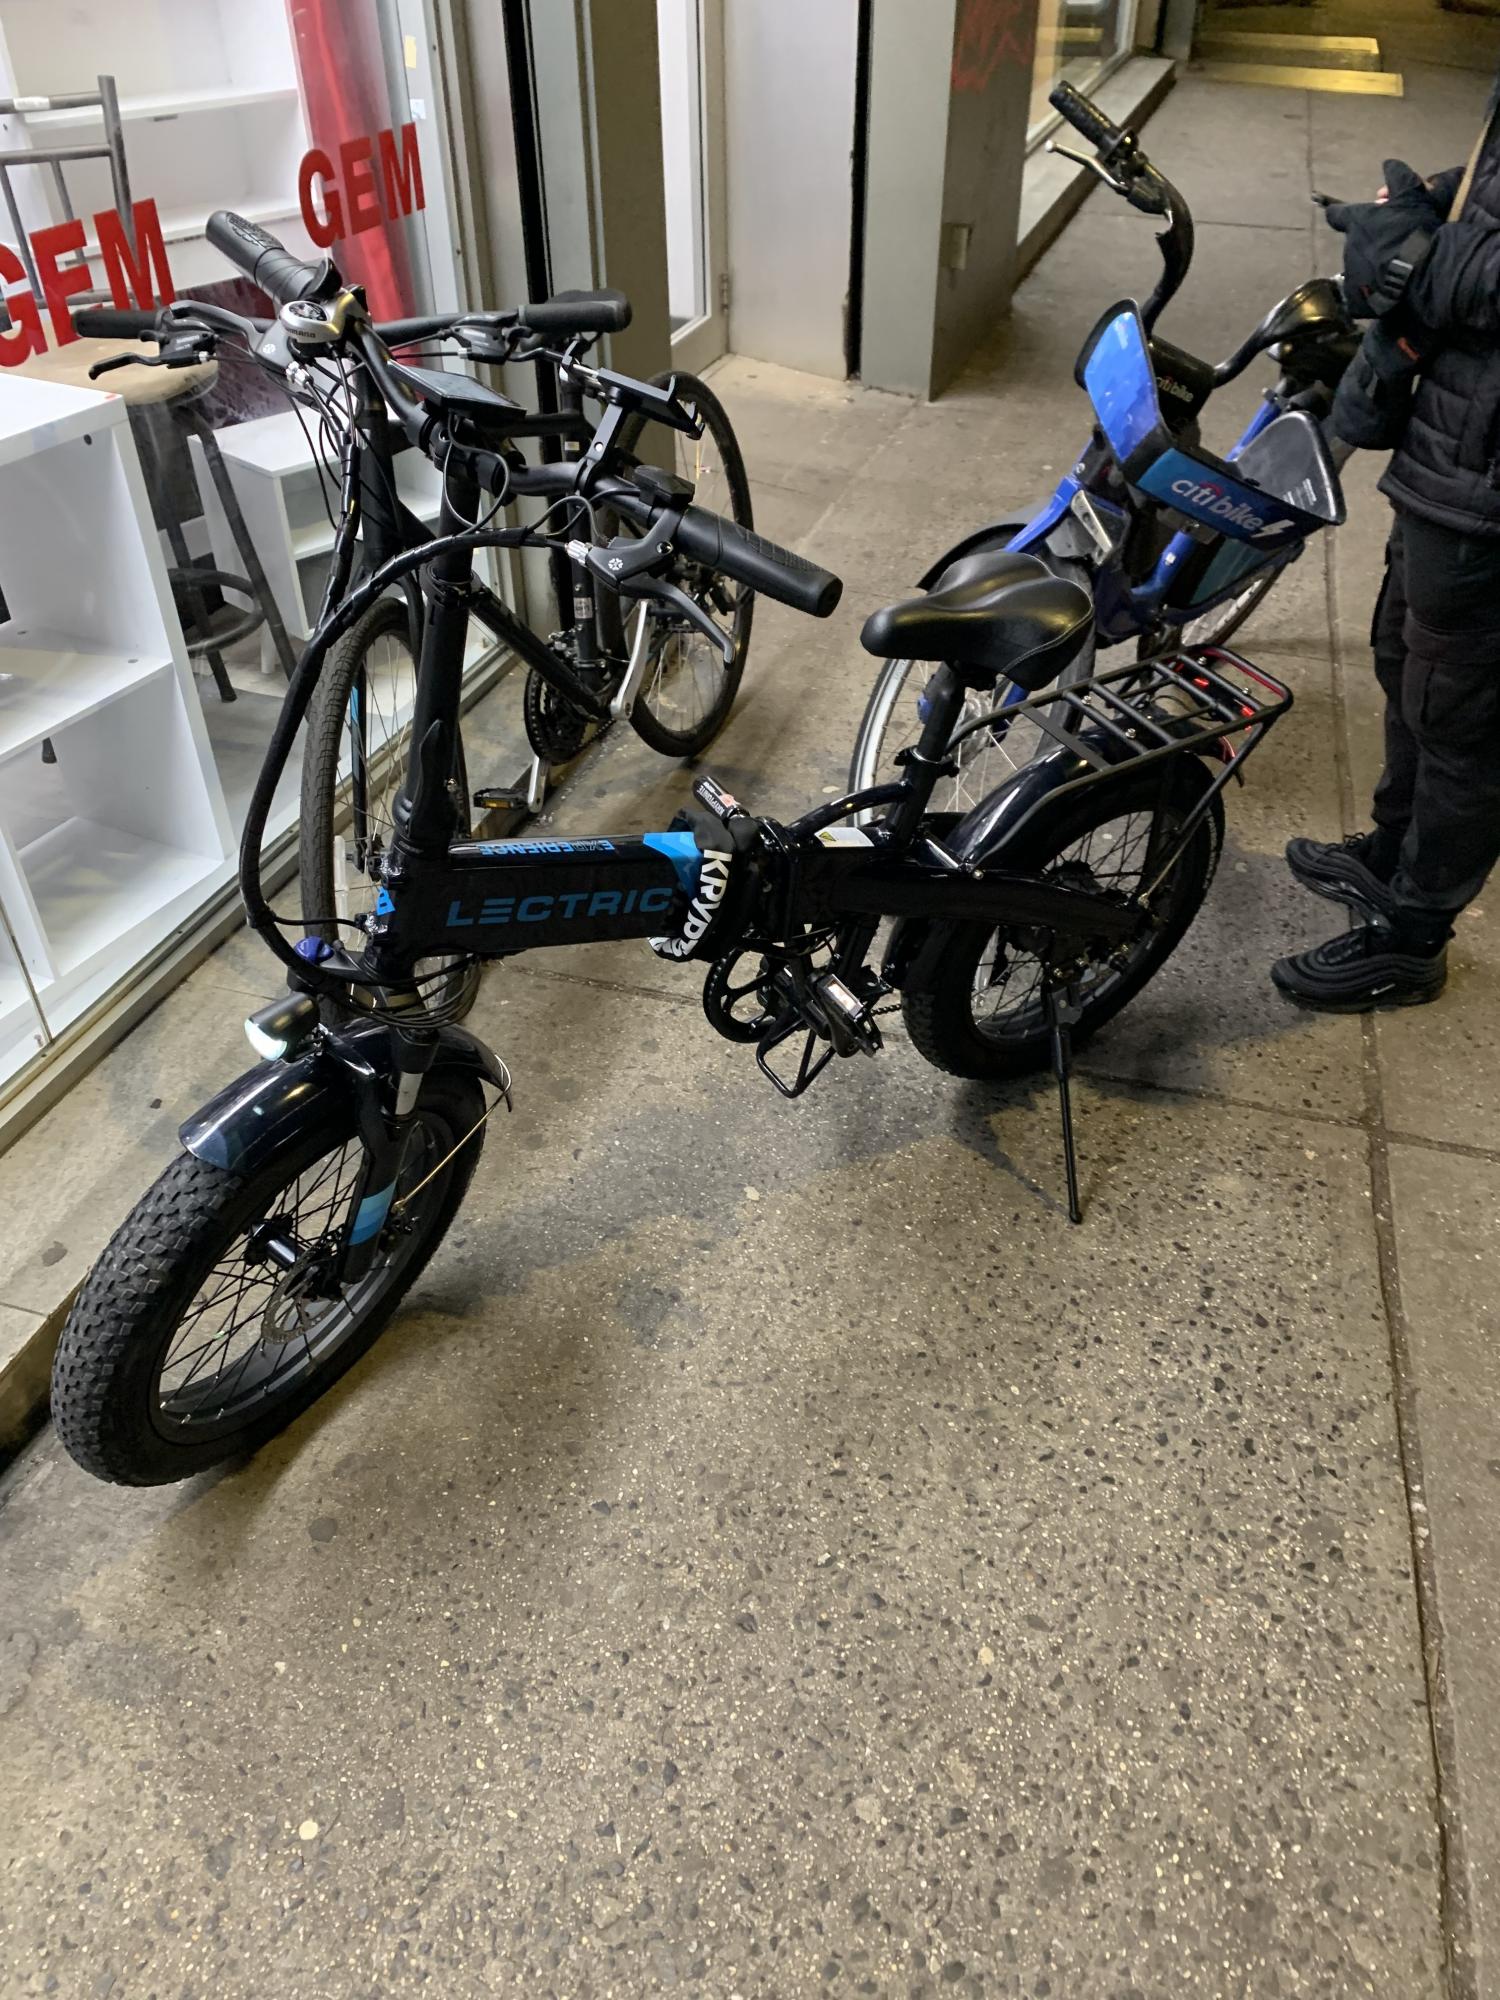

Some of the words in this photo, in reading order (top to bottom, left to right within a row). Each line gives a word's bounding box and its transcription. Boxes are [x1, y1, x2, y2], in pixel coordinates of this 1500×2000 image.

[298, 121, 426, 249] GEM
[0, 197, 176, 368] GEM
[446, 887, 673, 928] LECTRIC
